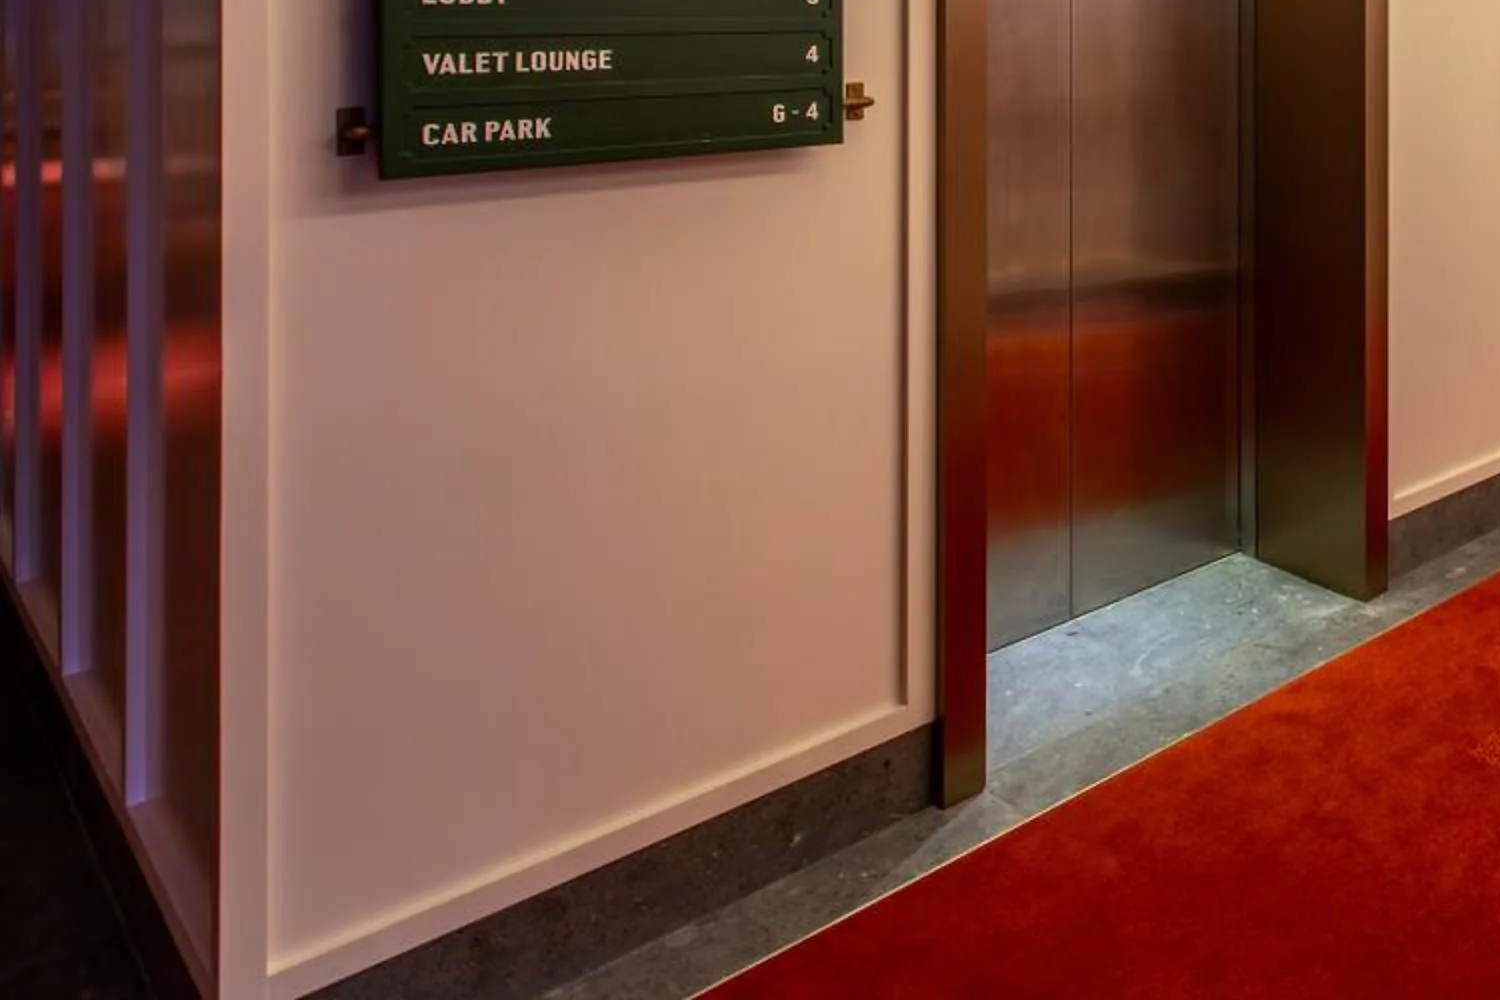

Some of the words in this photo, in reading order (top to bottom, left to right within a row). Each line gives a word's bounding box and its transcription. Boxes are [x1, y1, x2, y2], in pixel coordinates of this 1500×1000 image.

[422, 52, 509, 74] VALET
[516, 49, 612, 72] LOUNGE
[805, 45, 819, 63] 4
[423, 122, 477, 145] CAR
[485, 117, 551, 141] PARK
[805, 101, 819, 120] 4
